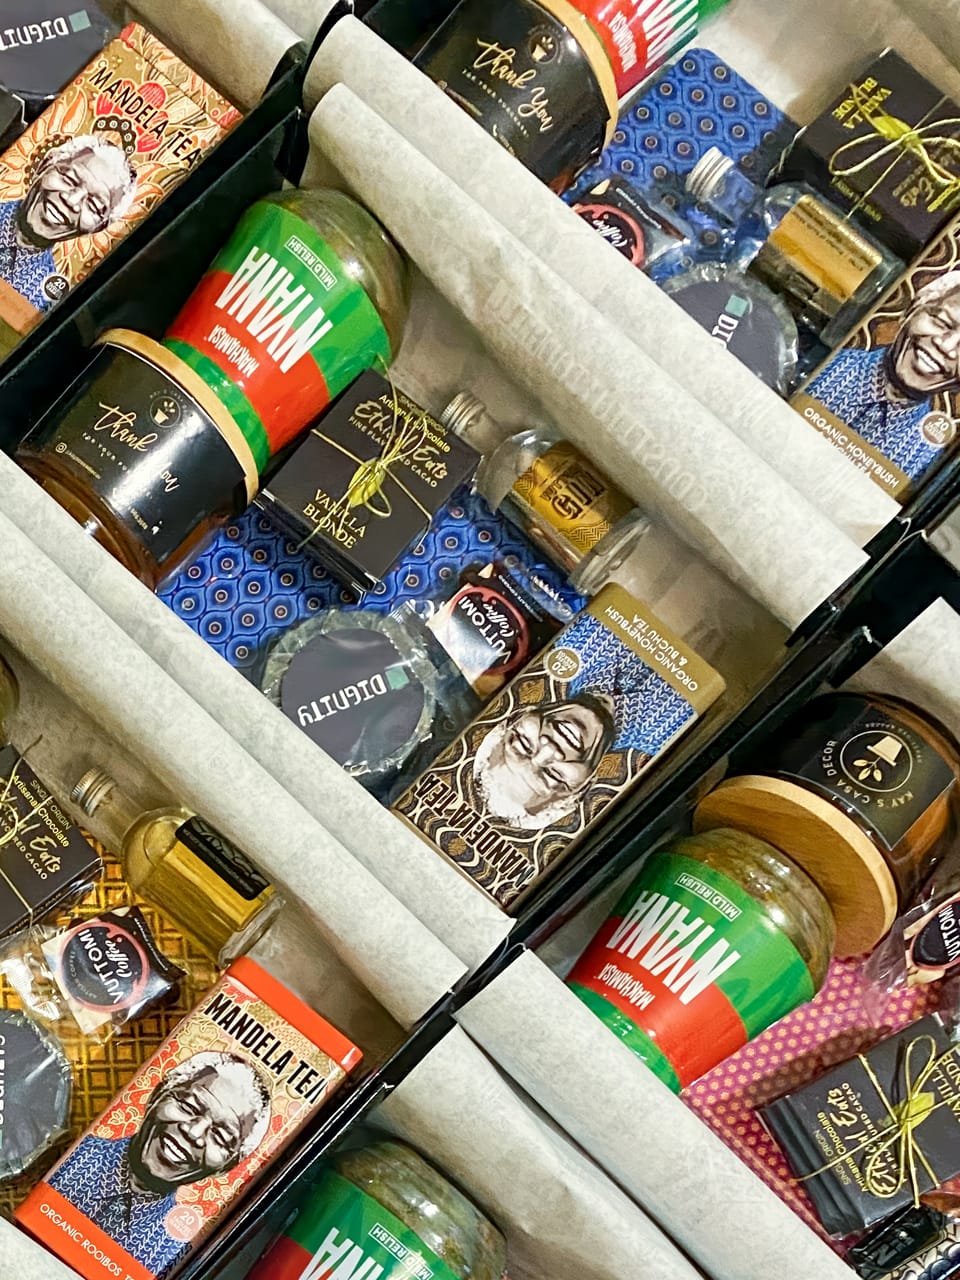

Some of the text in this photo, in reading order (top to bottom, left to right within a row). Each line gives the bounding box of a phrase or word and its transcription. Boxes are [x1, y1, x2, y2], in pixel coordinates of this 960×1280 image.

[89, 66, 203, 168] MANDELA TEA
[288, 238, 336, 288] MILD RELISH
[214, 246, 332, 373] NYANA
[207, 324, 260, 377] MAKHAMISA
[803, 407, 849, 448] ORGANIC
[845, 441, 900, 489] HONEYBUSH
[604, 606, 698, 692] ORGANIC HONEYBUSH
[633, 613, 652, 634] TEA
[651, 629, 681, 658] BUCHU
[298, 672, 387, 728] DIGNITY
[38, 807, 70, 848] Chocolate
[416, 773, 536, 888] MANDELA TEA
[25, 852, 49, 881] CACAO
[678, 875, 742, 921] MILD RELISH
[78, 929, 124, 1004] VUTTOMI
[105, 933, 132, 978] Coffee
[606, 890, 741, 1005] NYANA
[593, 963, 655, 1010] MAKHAMISA
[204, 992, 328, 1105] MANDELA TEA
[842, 1083, 863, 1112] CACAO
[817, 1111, 847, 1155] Chocolate
[39, 1203, 85, 1244] ORGANIC
[80, 1240, 123, 1277] ROOIBOS
[372, 1223, 408, 1260] RELISH
